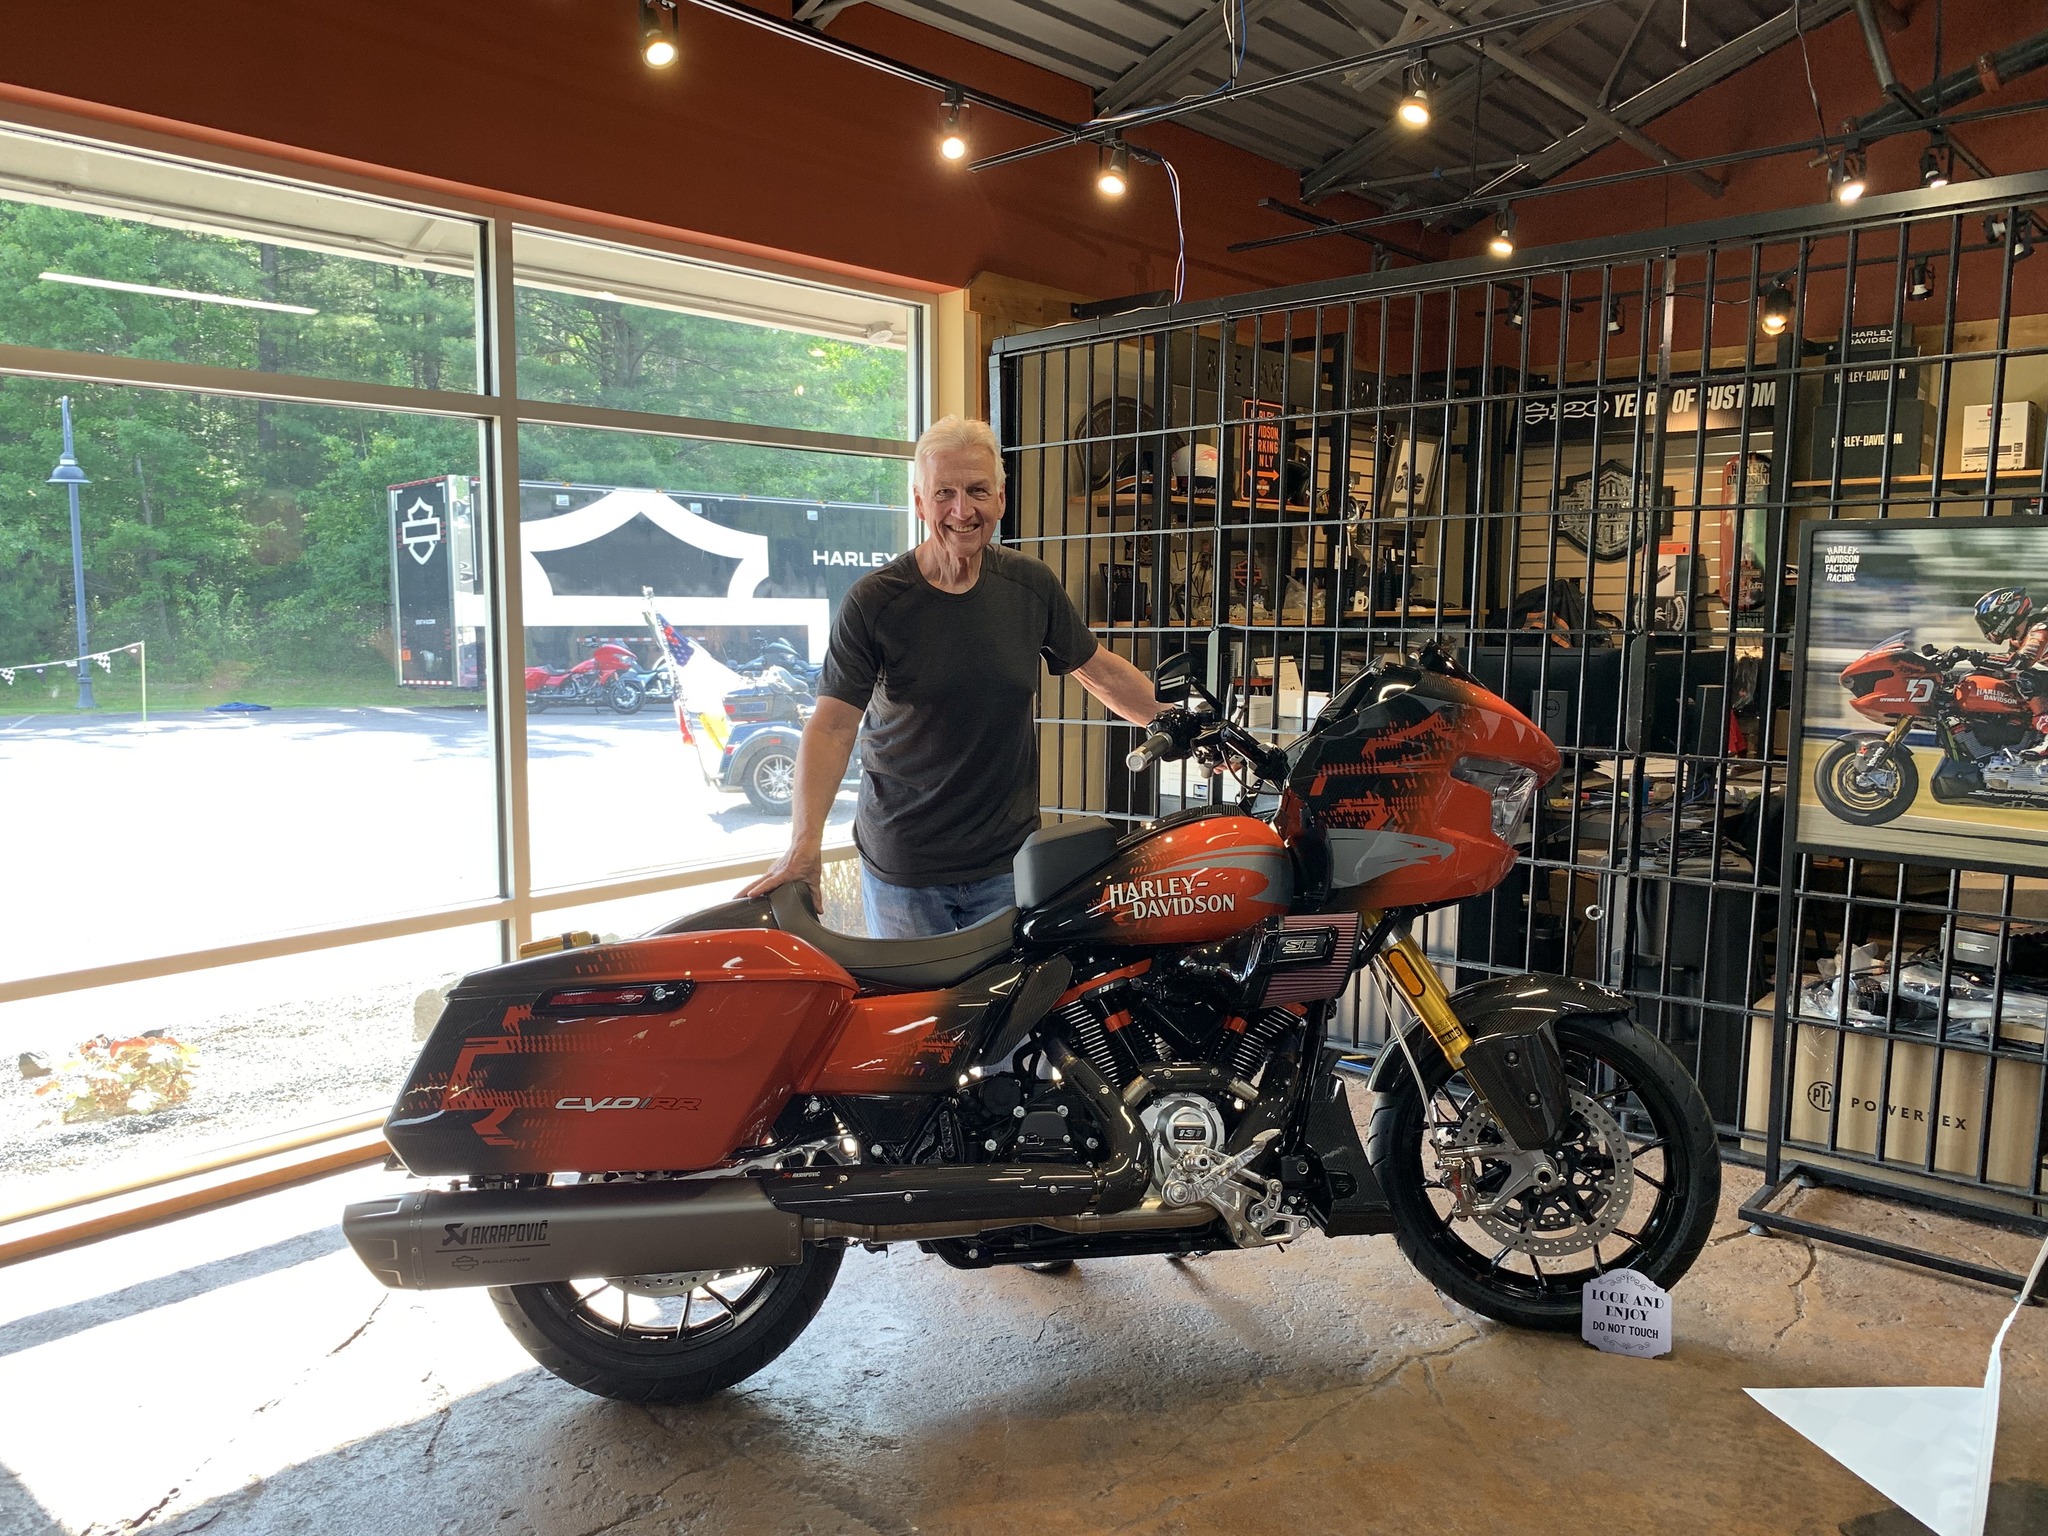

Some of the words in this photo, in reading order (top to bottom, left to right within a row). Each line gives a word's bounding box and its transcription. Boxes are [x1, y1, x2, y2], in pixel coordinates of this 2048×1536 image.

[1850, 336, 1894, 345] AVIDSO
[1834, 368, 1906, 384] HLEY-DAVIDN
[1614, 391, 1660, 418] YER
[1672, 388, 1696, 414] OF
[1248, 438, 1279, 454] PRKING
[1831, 433, 1903, 448] HRLEY-DAVIDN
[1256, 454, 1274, 468] NLY
[812, 550, 899, 567] HARLEY
[1824, 555, 1860, 564] DAVIDSON
[1825, 564, 1857, 573] FACTORY
[1984, 693, 2018, 705] DAVIDSON
[1133, 893, 1235, 920] DAVIDSON
[1850, 1097, 1967, 1131] POWEREX
[1591, 1288, 1629, 1305] LOOK
[1633, 1295, 1665, 1310] AND
[1605, 1305, 1650, 1322] ENJOY
[1592, 1320, 1605, 1331] DO
[1608, 1323, 1626, 1335] NOT
[1629, 1325, 1659, 1339] TOUCH
